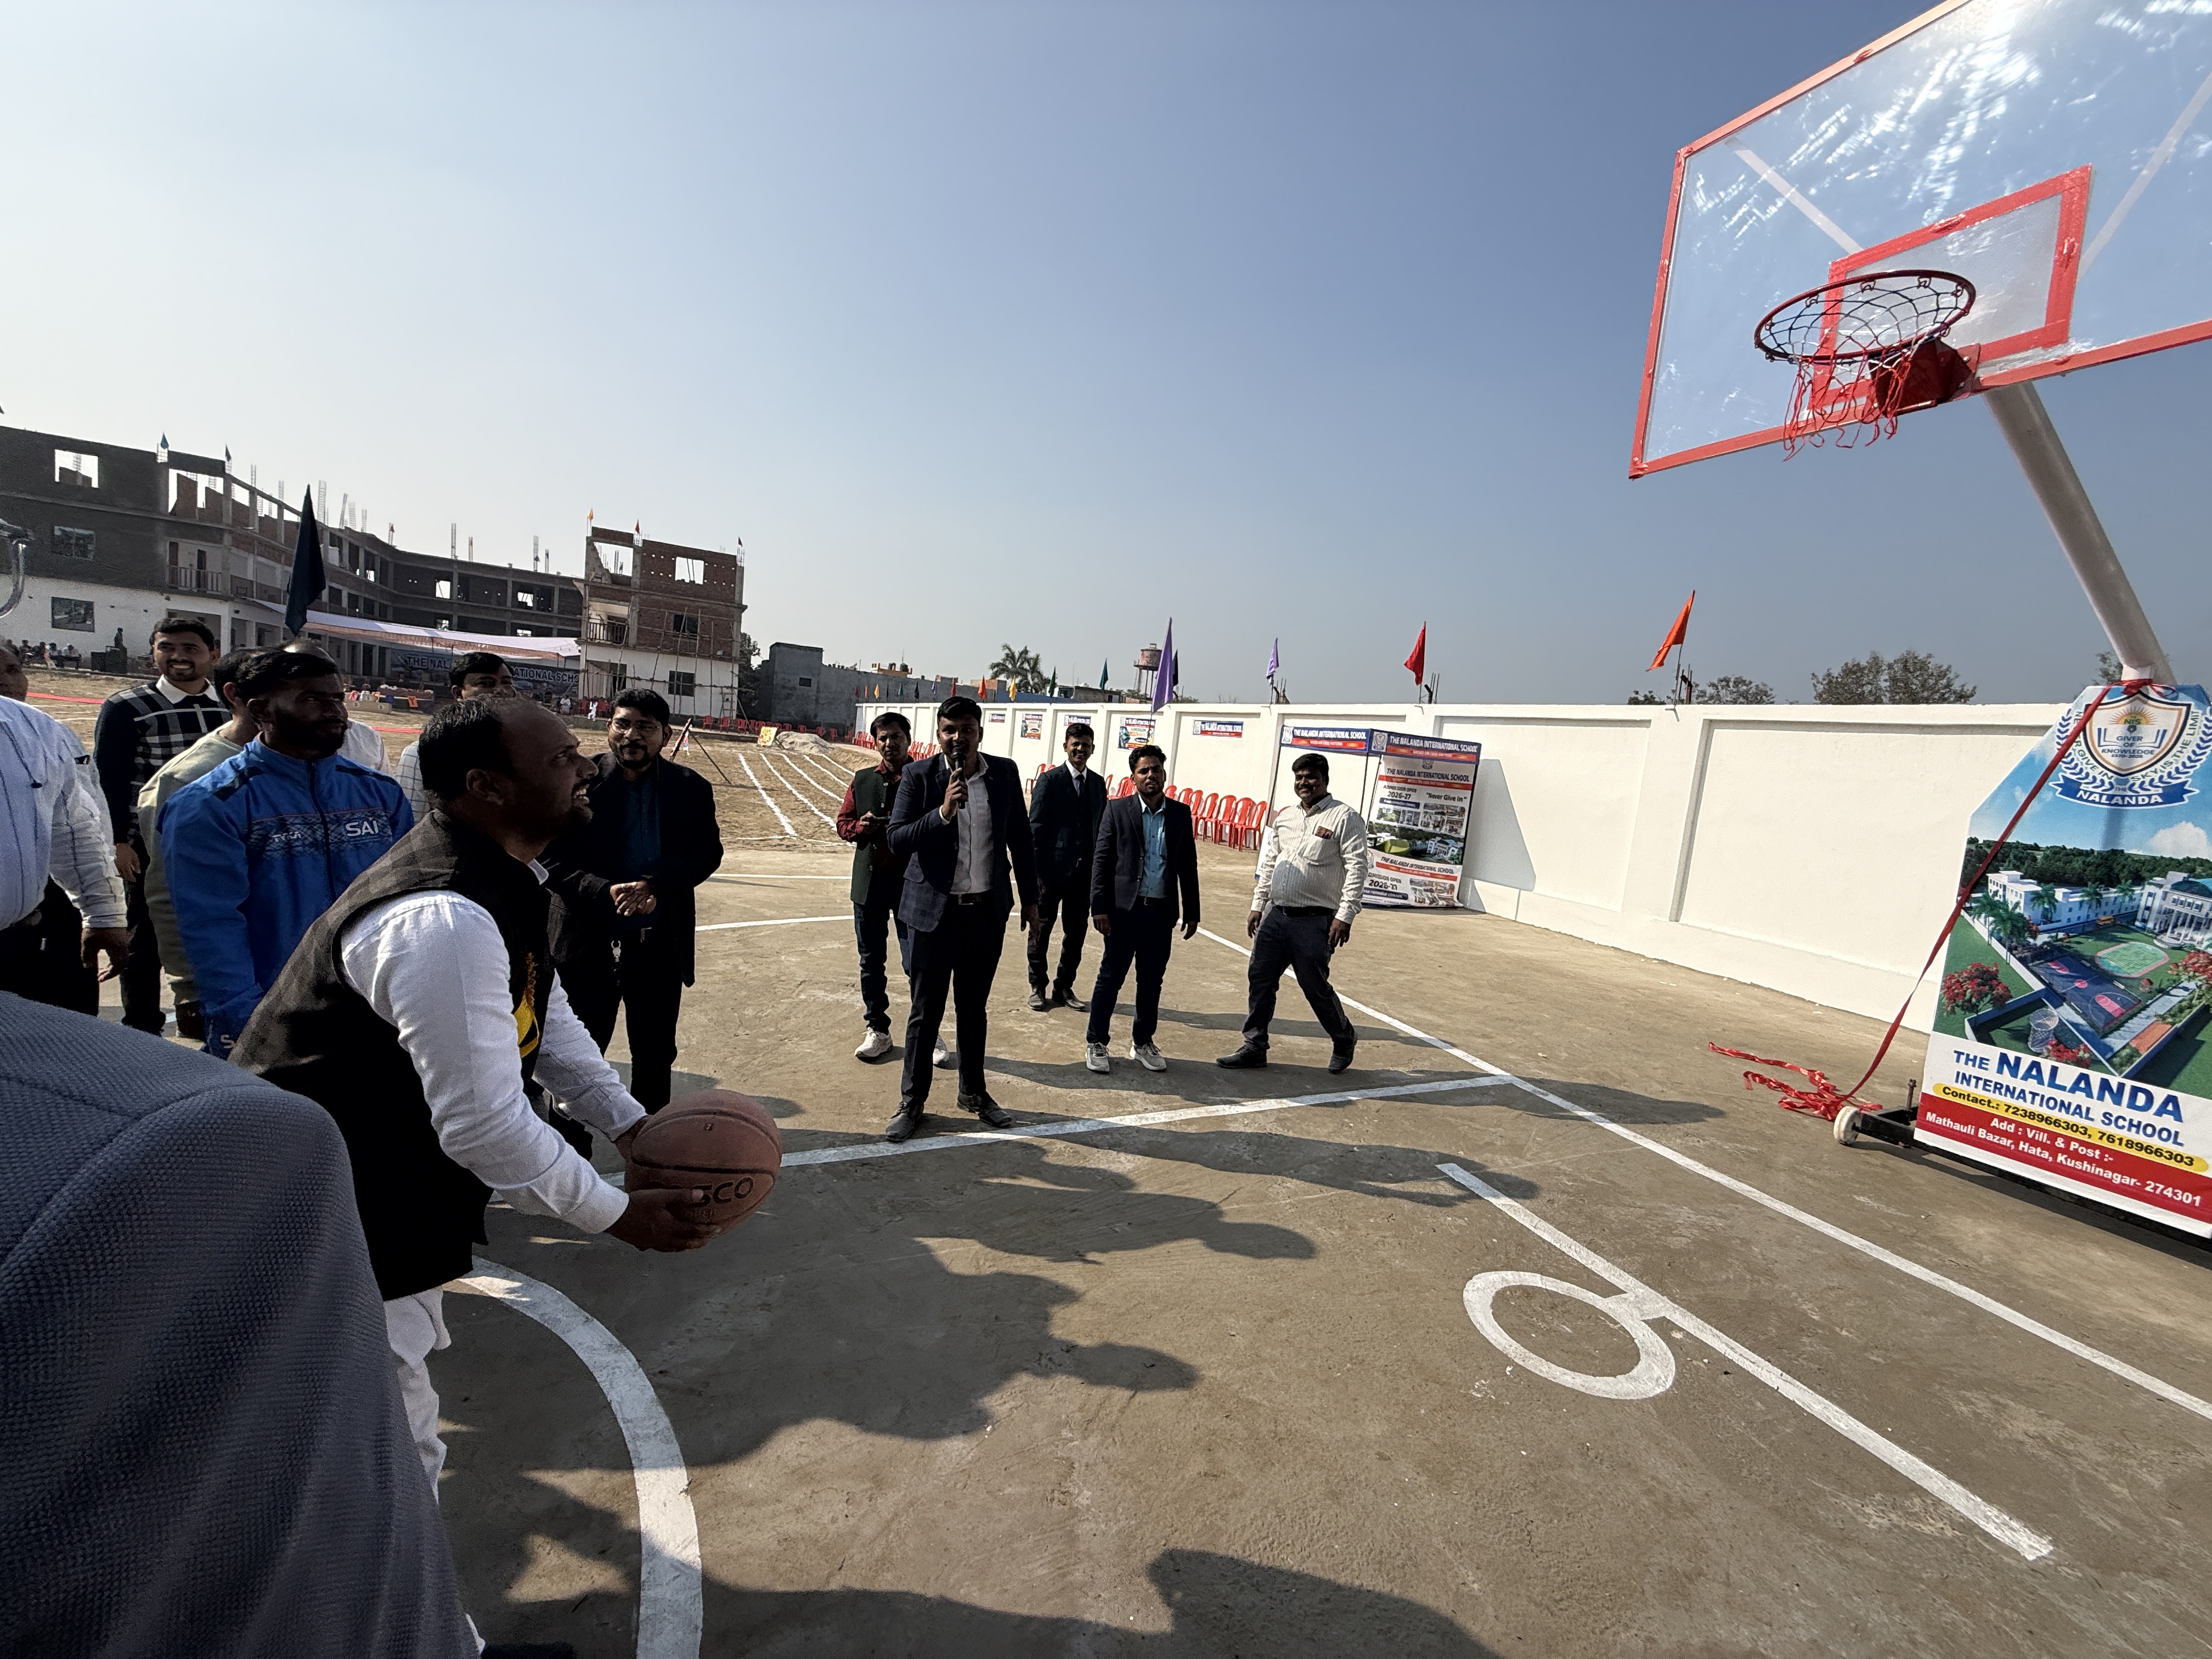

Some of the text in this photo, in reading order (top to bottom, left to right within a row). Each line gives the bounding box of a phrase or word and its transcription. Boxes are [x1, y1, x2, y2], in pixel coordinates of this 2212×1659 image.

[406, 656, 427, 668] THE
[1390, 736, 1400, 744] THE
[2130, 768, 2158, 781] SKY
[2172, 739, 2192, 758] THE
[2186, 711, 2200, 736] LIMIT
[1417, 771, 1450, 781] INTERNATIONAL
[1387, 791, 1412, 800] 2026-27
[2076, 790, 2164, 805] NALANDA
[345, 820, 379, 837] SAI
[1954, 1049, 2183, 1123] THE NALANDA
[1954, 1071, 2185, 1147] INTERNATIONAL SCHOOL
[1990, 1117, 2015, 1133] Add
[2026, 1127, 2051, 1144] Vill.
[2055, 1137, 2066, 1148] &
[2069, 1141, 2101, 1159] Post
[2004, 1103, 2092, 1139] 7238966303,
[2098, 1131, 2194, 1167] 7618966303
[1926, 1111, 2202, 1207] Mathauli Bazar, Hata, Kushinagar- 274301
